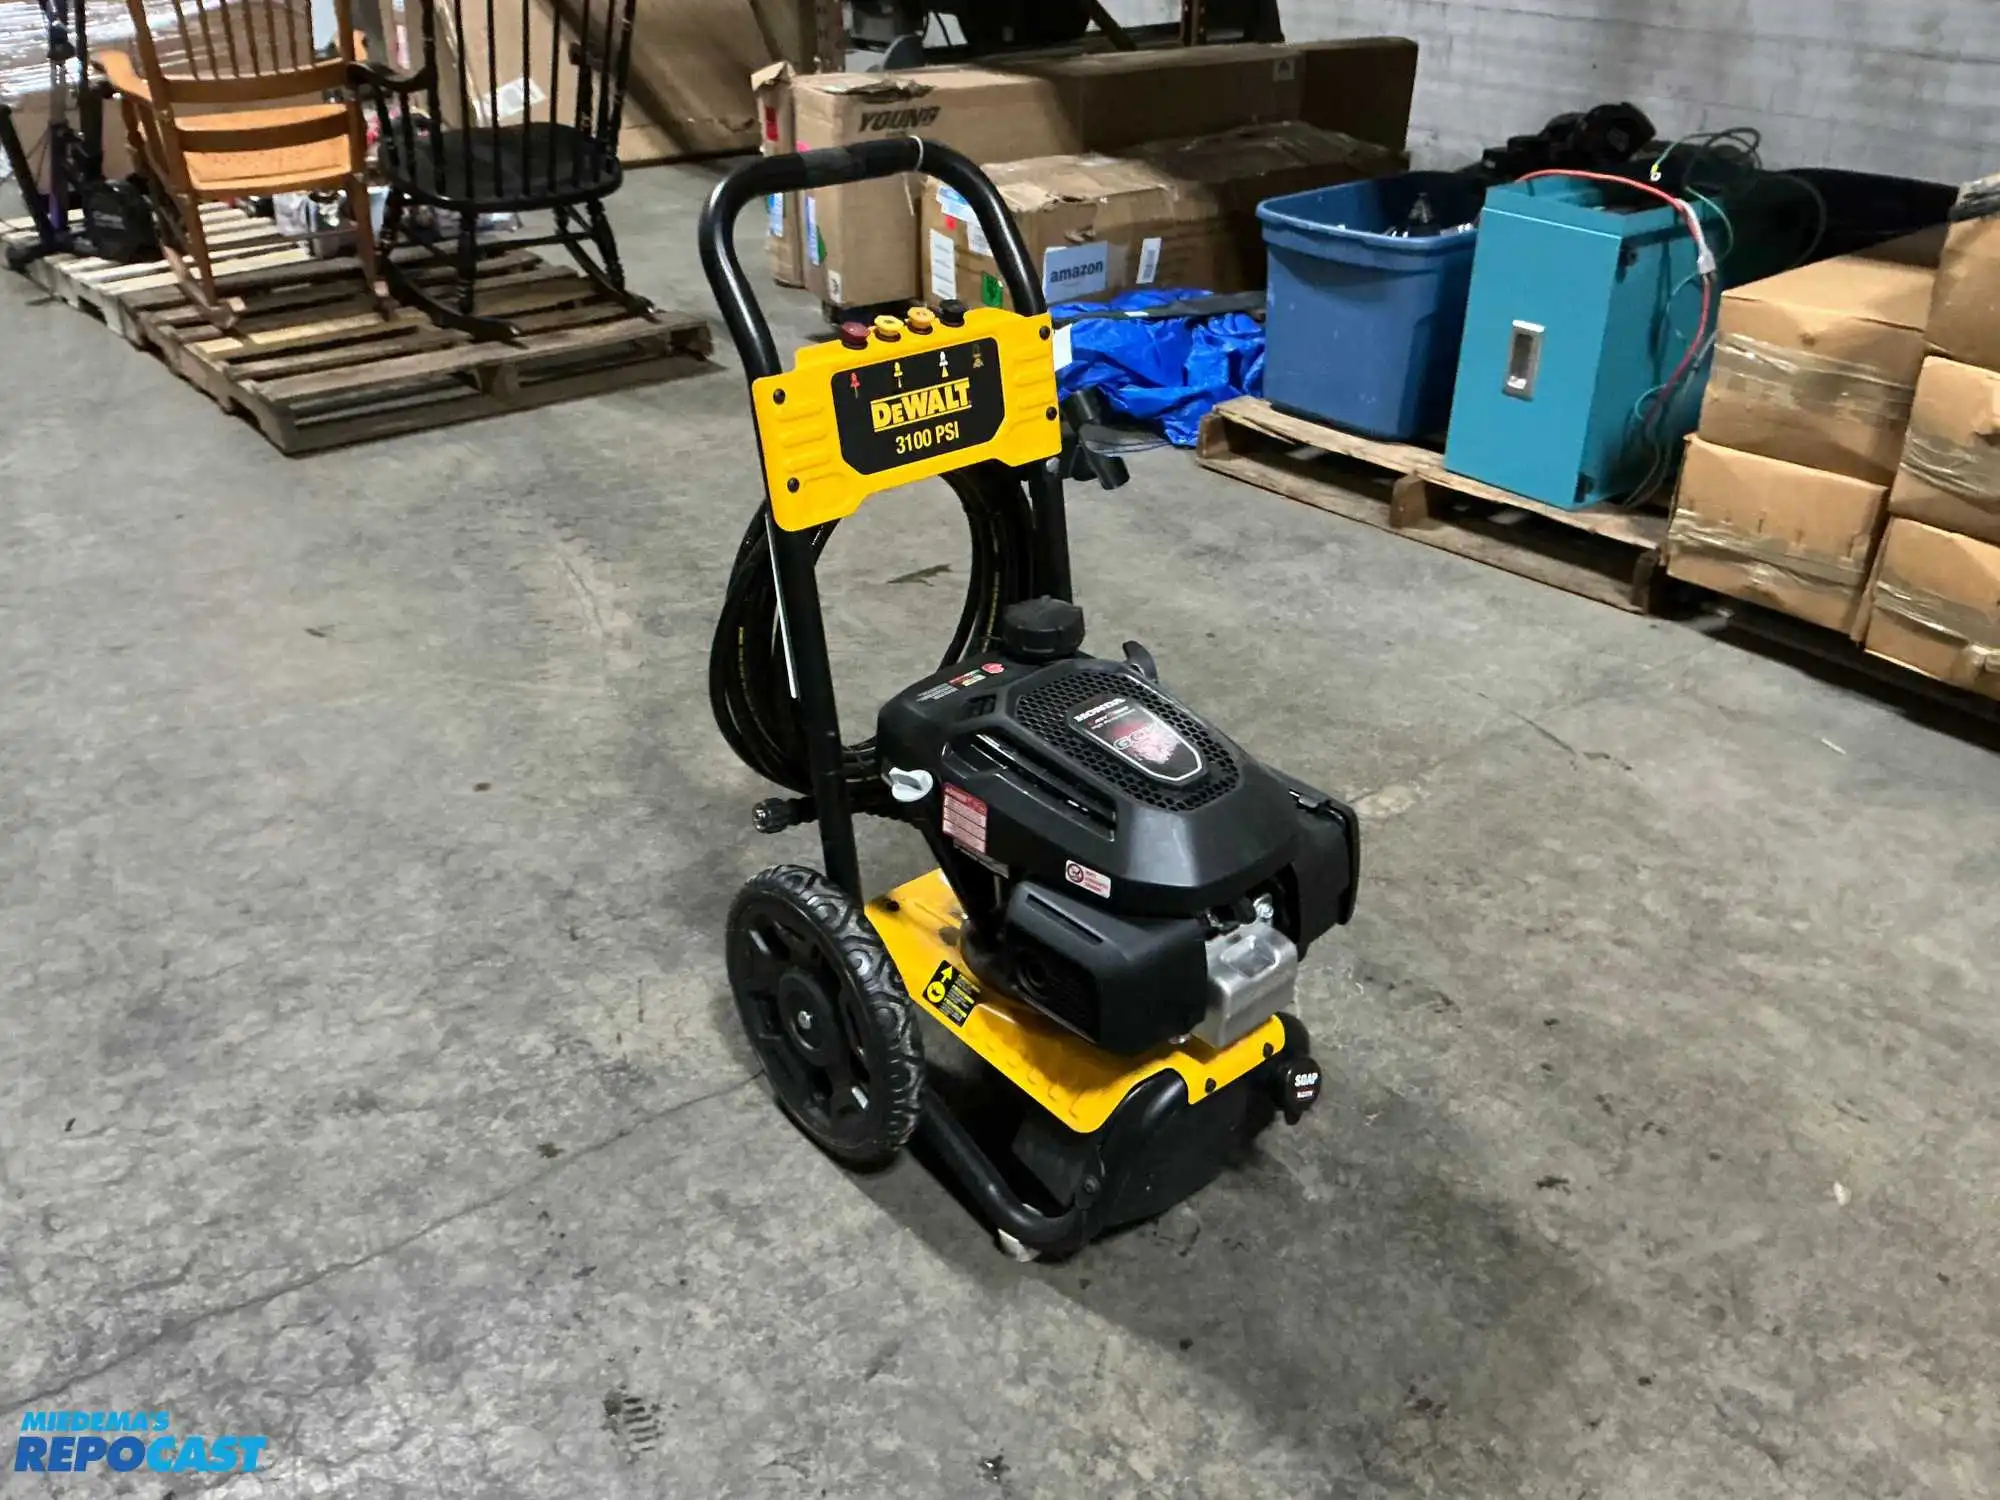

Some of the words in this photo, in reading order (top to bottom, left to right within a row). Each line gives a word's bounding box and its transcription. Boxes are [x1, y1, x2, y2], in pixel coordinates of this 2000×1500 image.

[1050, 260, 1104, 283] amazon
[895, 430, 932, 455] 3100
[936, 420, 960, 445] PSI
[1073, 698, 1126, 722] HONDA
[1294, 1072, 1319, 1087] SOAP
